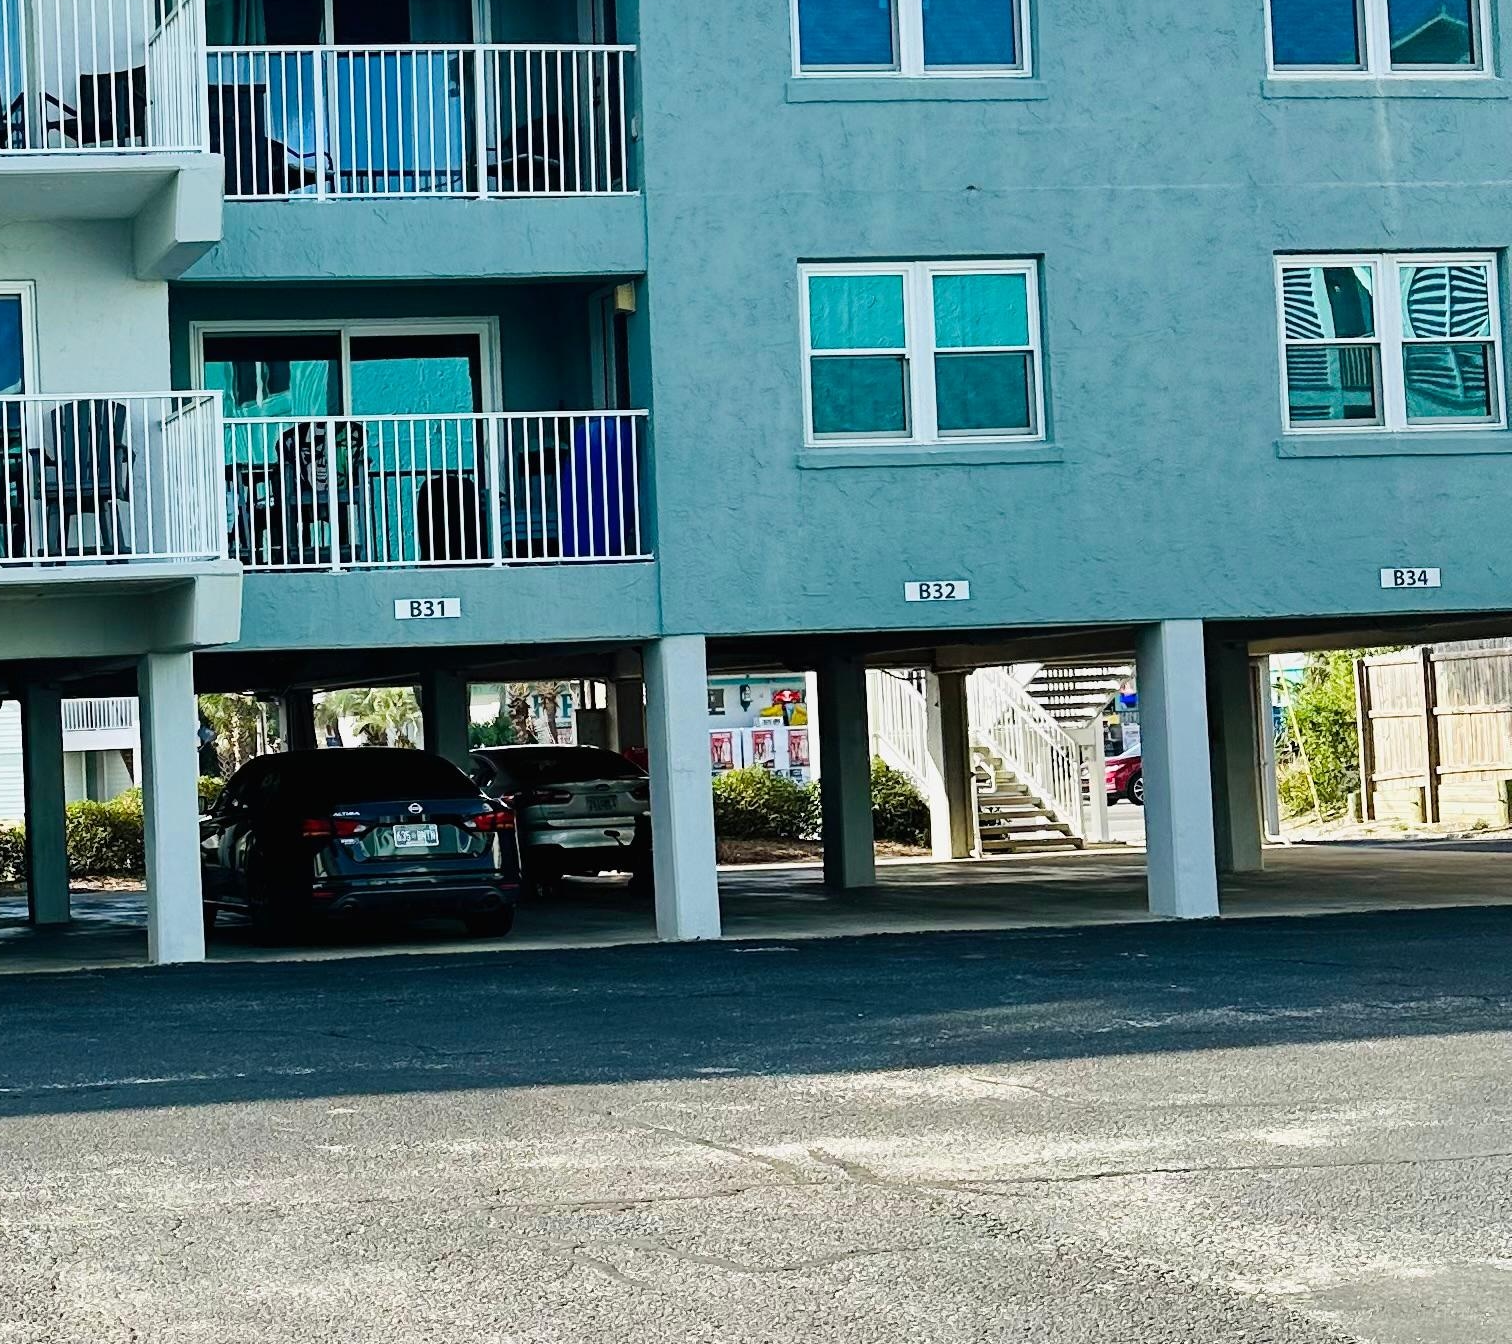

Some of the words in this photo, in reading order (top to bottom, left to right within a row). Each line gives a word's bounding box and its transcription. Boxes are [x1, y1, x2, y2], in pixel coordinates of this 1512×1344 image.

[1394, 570, 1428, 586] B34
[919, 583, 956, 599] B32
[410, 601, 445, 617] B31
